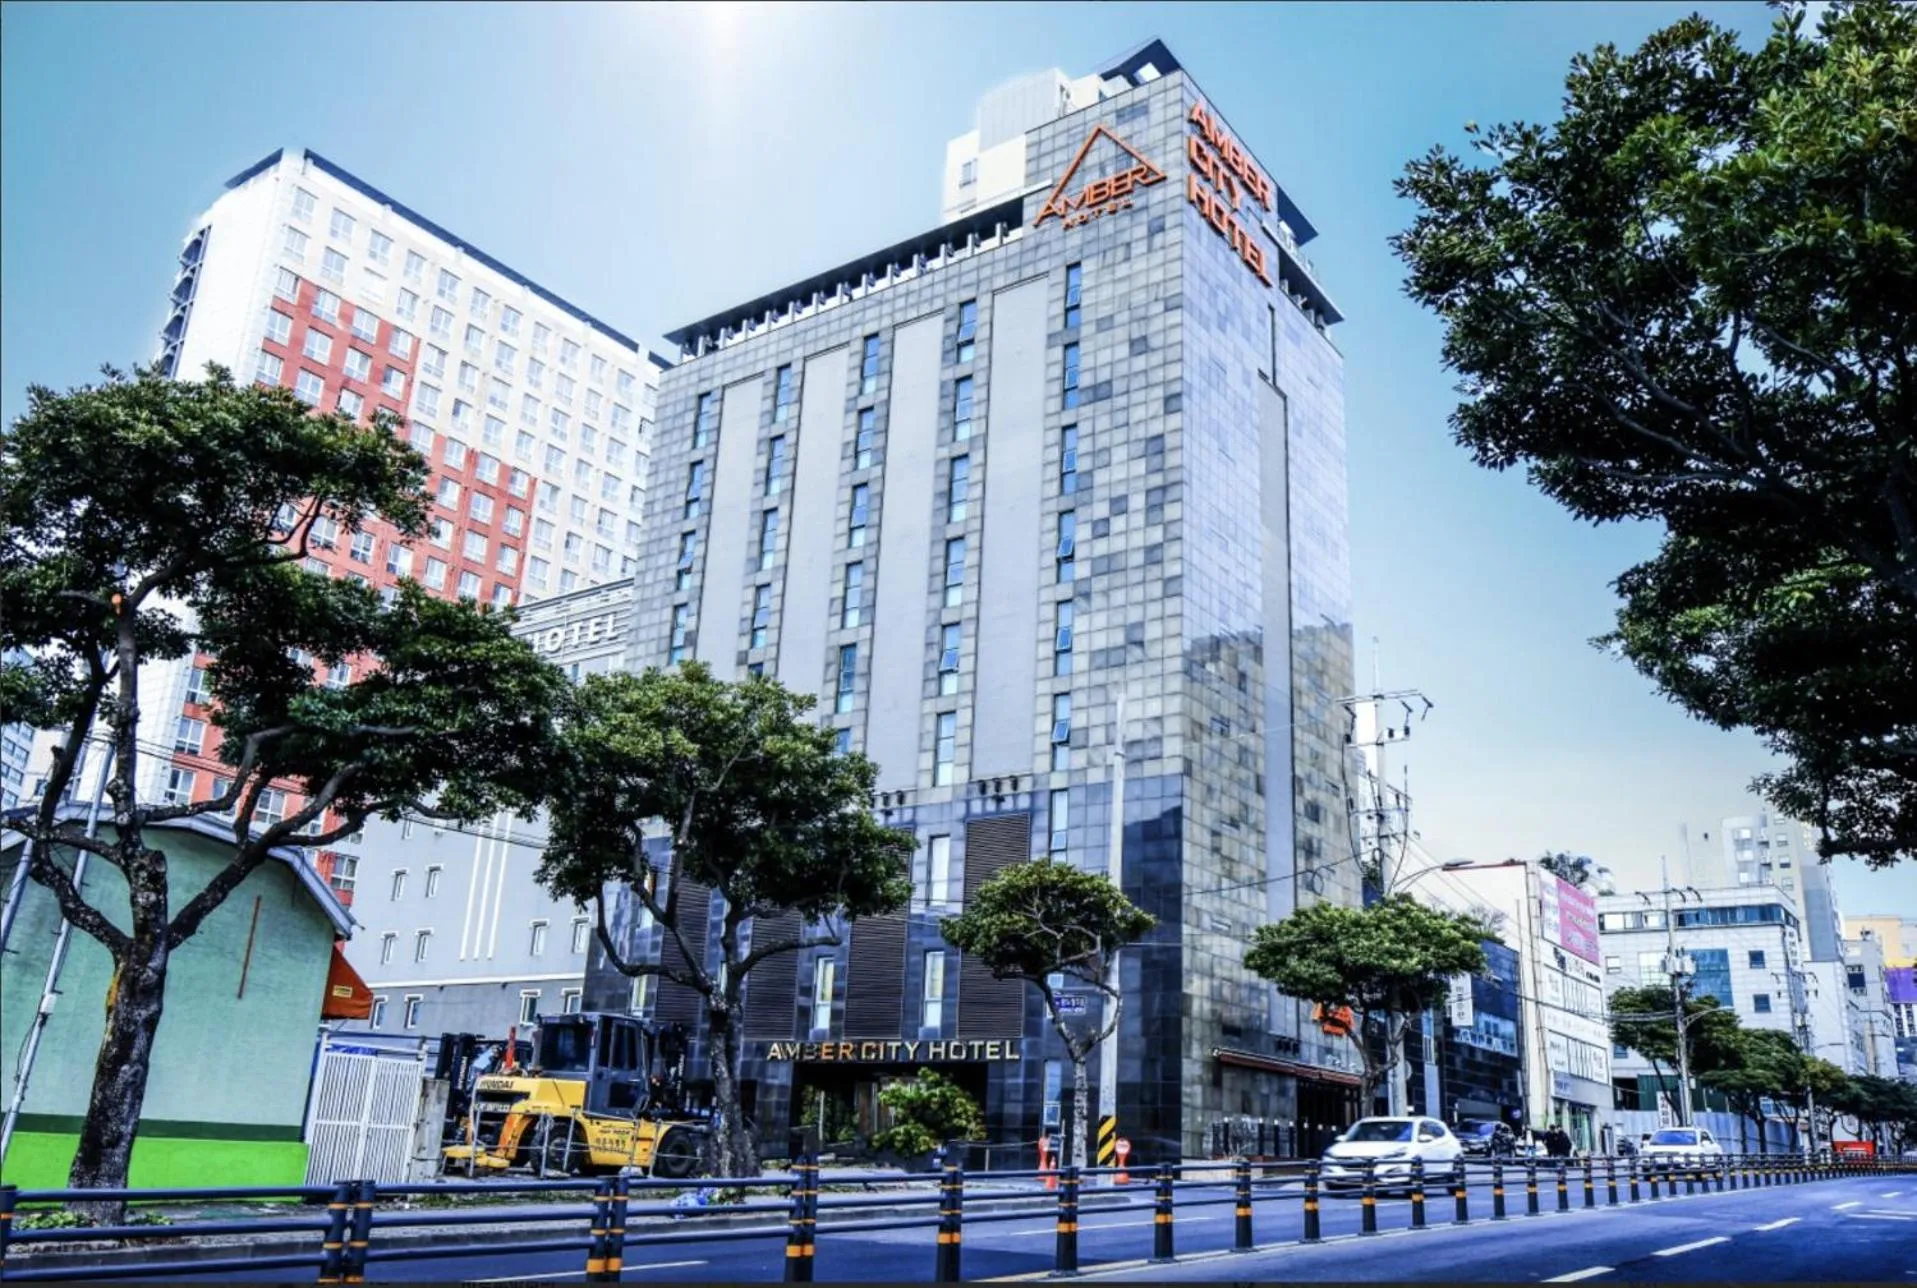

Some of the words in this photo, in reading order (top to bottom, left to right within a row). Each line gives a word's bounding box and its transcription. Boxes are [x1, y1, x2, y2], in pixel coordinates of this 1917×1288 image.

[1188, 102, 1270, 212] AMBER
[1188, 135, 1242, 212] CITY
[1033, 164, 1166, 228] AMBER
[1188, 174, 1273, 288] HOTEL
[767, 1042, 854, 1060] AMBER
[861, 1041, 920, 1060] CITY
[929, 1041, 1020, 1060] HOTEL
